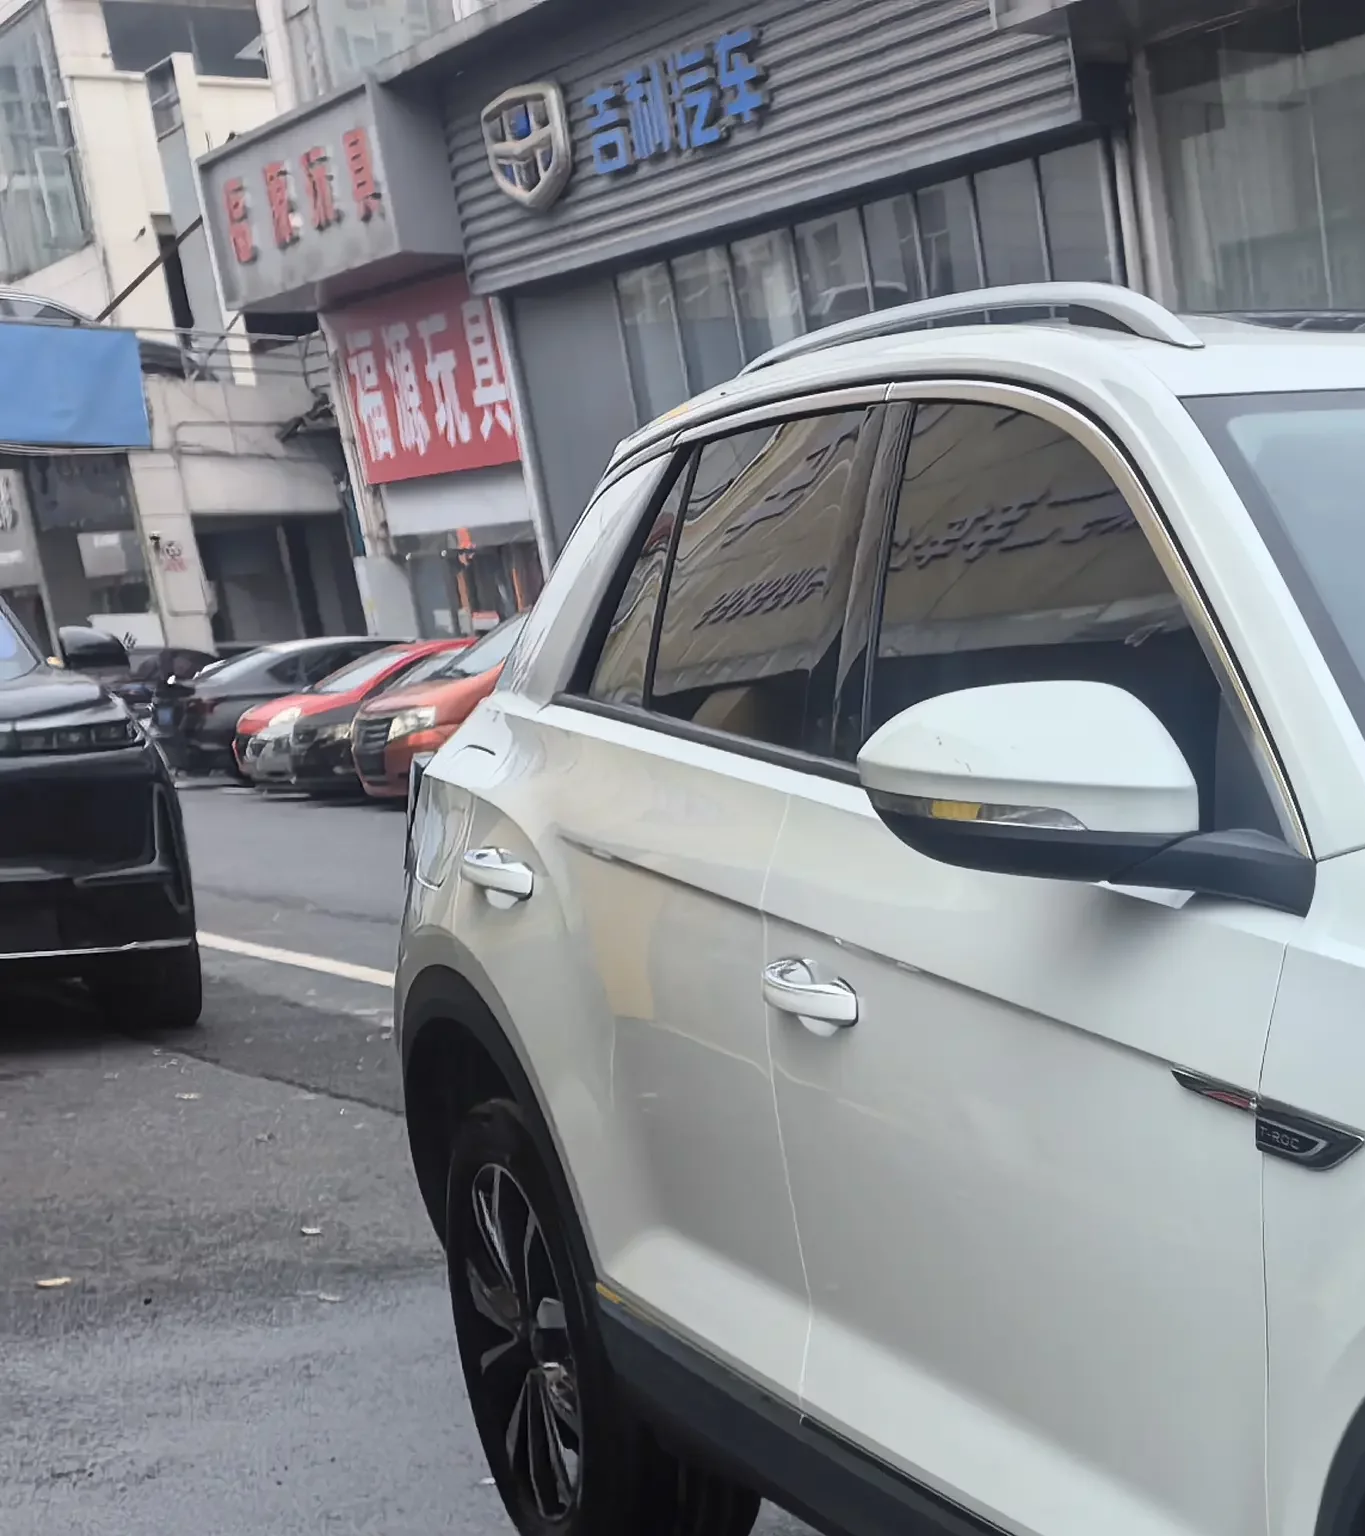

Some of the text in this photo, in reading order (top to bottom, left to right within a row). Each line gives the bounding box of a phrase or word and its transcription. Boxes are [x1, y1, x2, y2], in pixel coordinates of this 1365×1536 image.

[584, 30, 766, 175] 吉利汽车
[346, 299, 514, 462] 福源玩具
[1260, 1126, 1300, 1150] T-ROC
